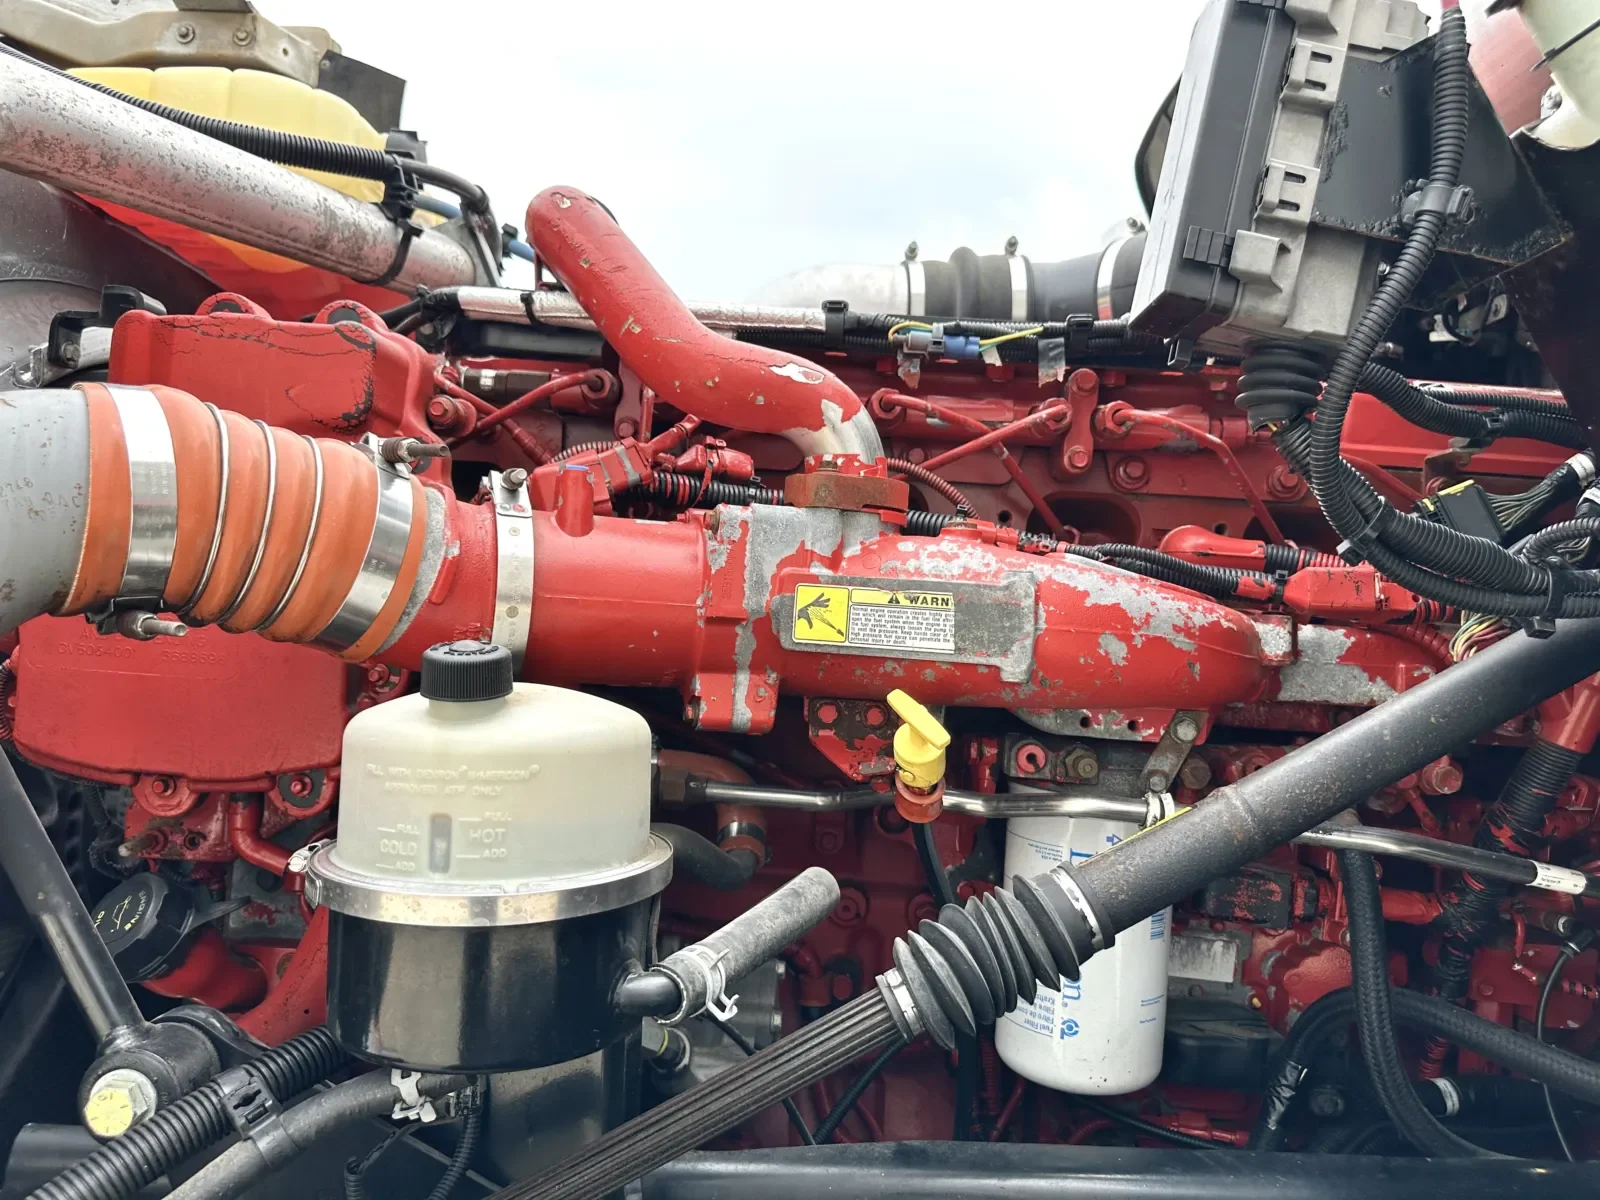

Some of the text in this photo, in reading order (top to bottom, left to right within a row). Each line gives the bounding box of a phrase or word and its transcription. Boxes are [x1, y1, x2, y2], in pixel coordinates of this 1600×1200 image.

[388, 767, 411, 778] WITH
[384, 782, 503, 796] APPROVED ATF ONLY
[484, 812, 512, 821] FULL
[396, 824, 420, 835] FULL
[470, 828, 506, 844] HOT
[380, 839, 417, 856] COLD
[483, 848, 507, 858] ADD
[395, 861, 416, 871] ADD
[124, 890, 148, 931] ENGINE
[1038, 1004, 1055, 1014] Filtre
[1038, 1014, 1054, 1024] Filtro
[1024, 1018, 1053, 1034] Fuel Filter
